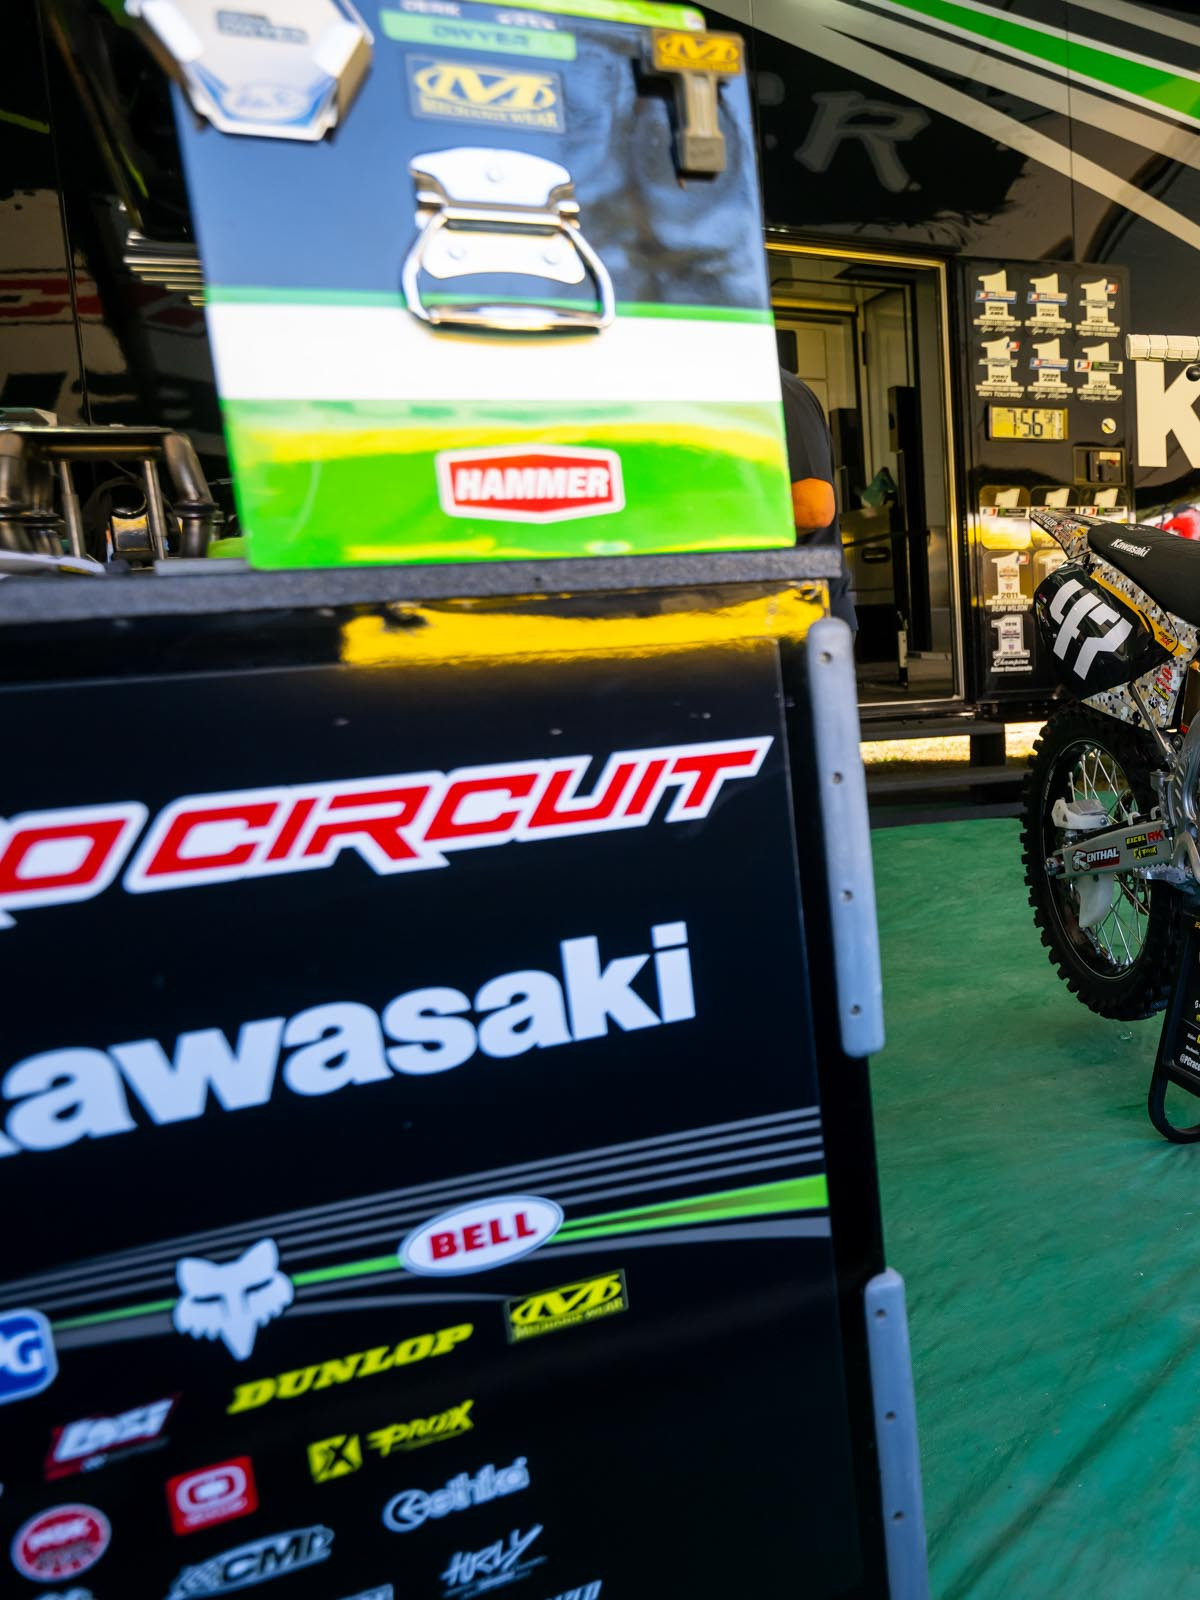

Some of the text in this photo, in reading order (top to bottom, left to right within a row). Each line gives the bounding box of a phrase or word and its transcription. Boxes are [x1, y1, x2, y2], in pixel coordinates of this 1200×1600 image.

[454, 467, 610, 502] HAMMER
[1110, 538, 1152, 558] Kawasaki
[123, 736, 774, 894] CIRCUIT
[0, 921, 697, 1158] awasaki
[428, 1210, 537, 1263] BELL
[226, 1323, 475, 1415] DUNLOP
